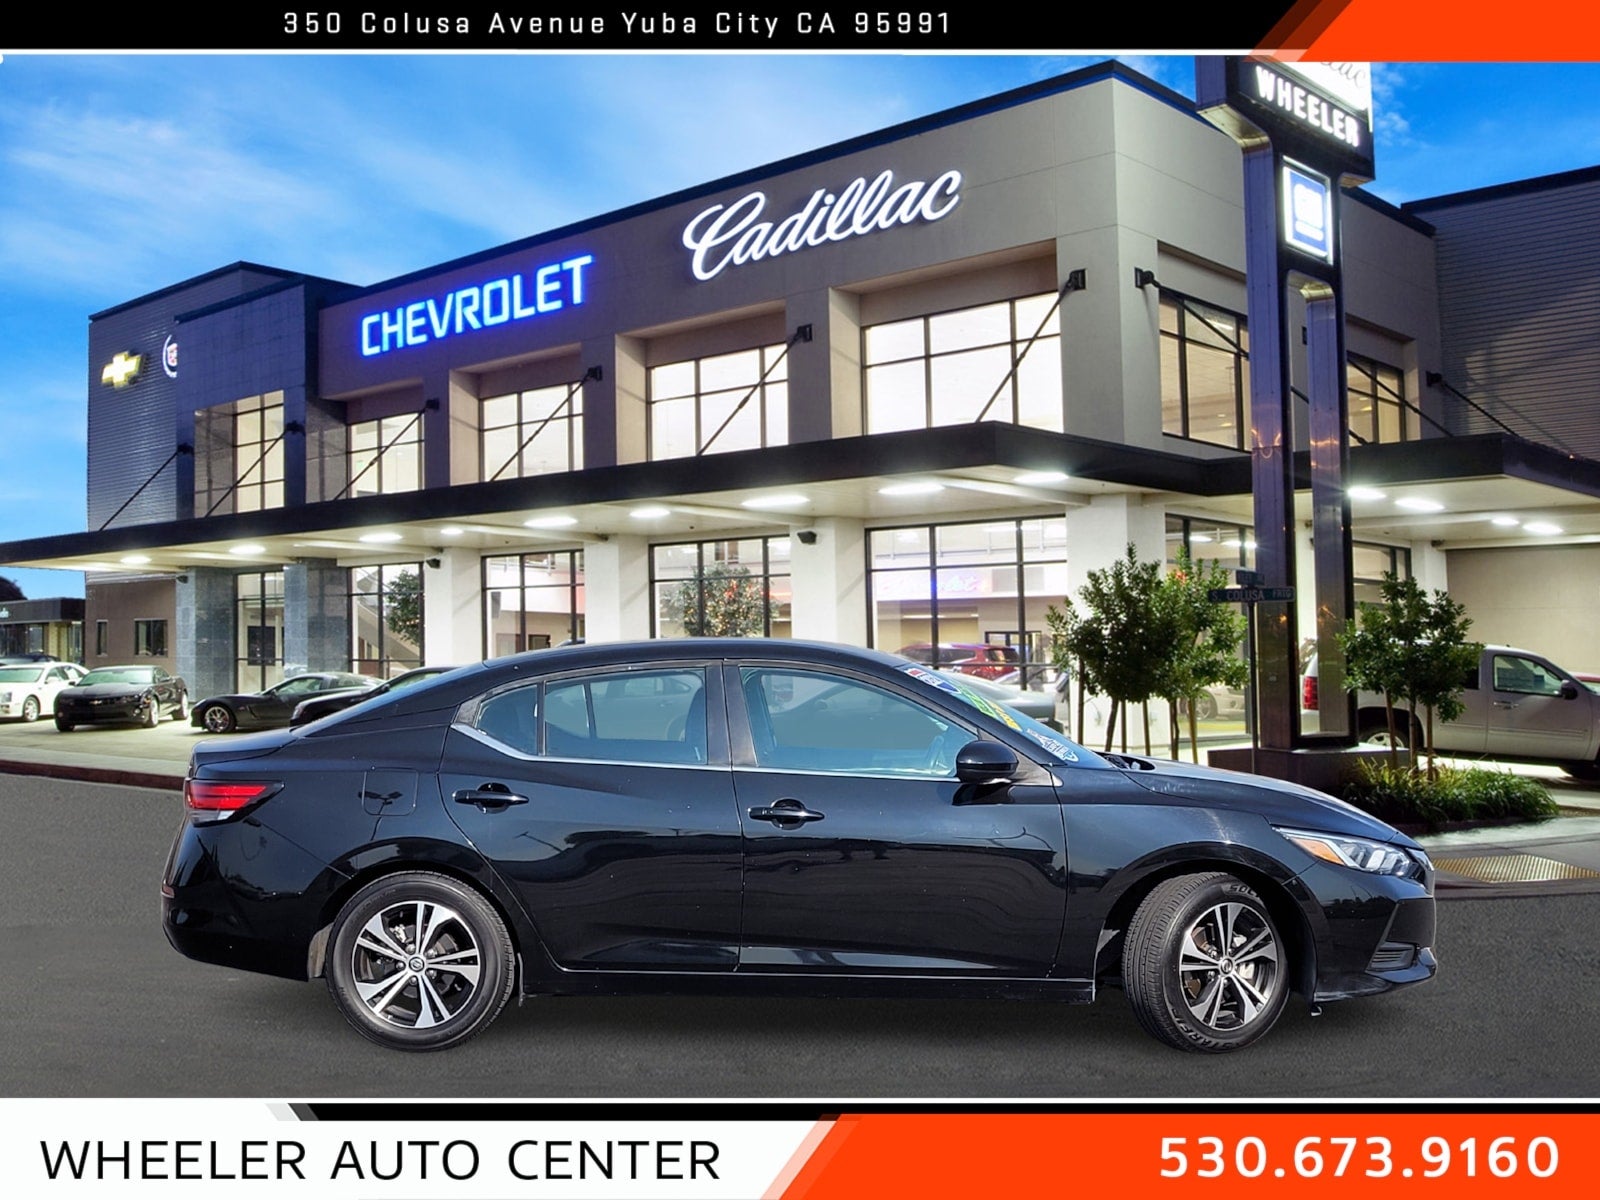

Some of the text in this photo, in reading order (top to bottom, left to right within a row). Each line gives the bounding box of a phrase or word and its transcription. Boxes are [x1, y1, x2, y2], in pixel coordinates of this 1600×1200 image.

[1255, 65, 1360, 147] WHEELER
[682, 169, 962, 281] Cadillac
[361, 254, 592, 356] CHEVROLET
[1226, 589, 1265, 601] COLUSA
